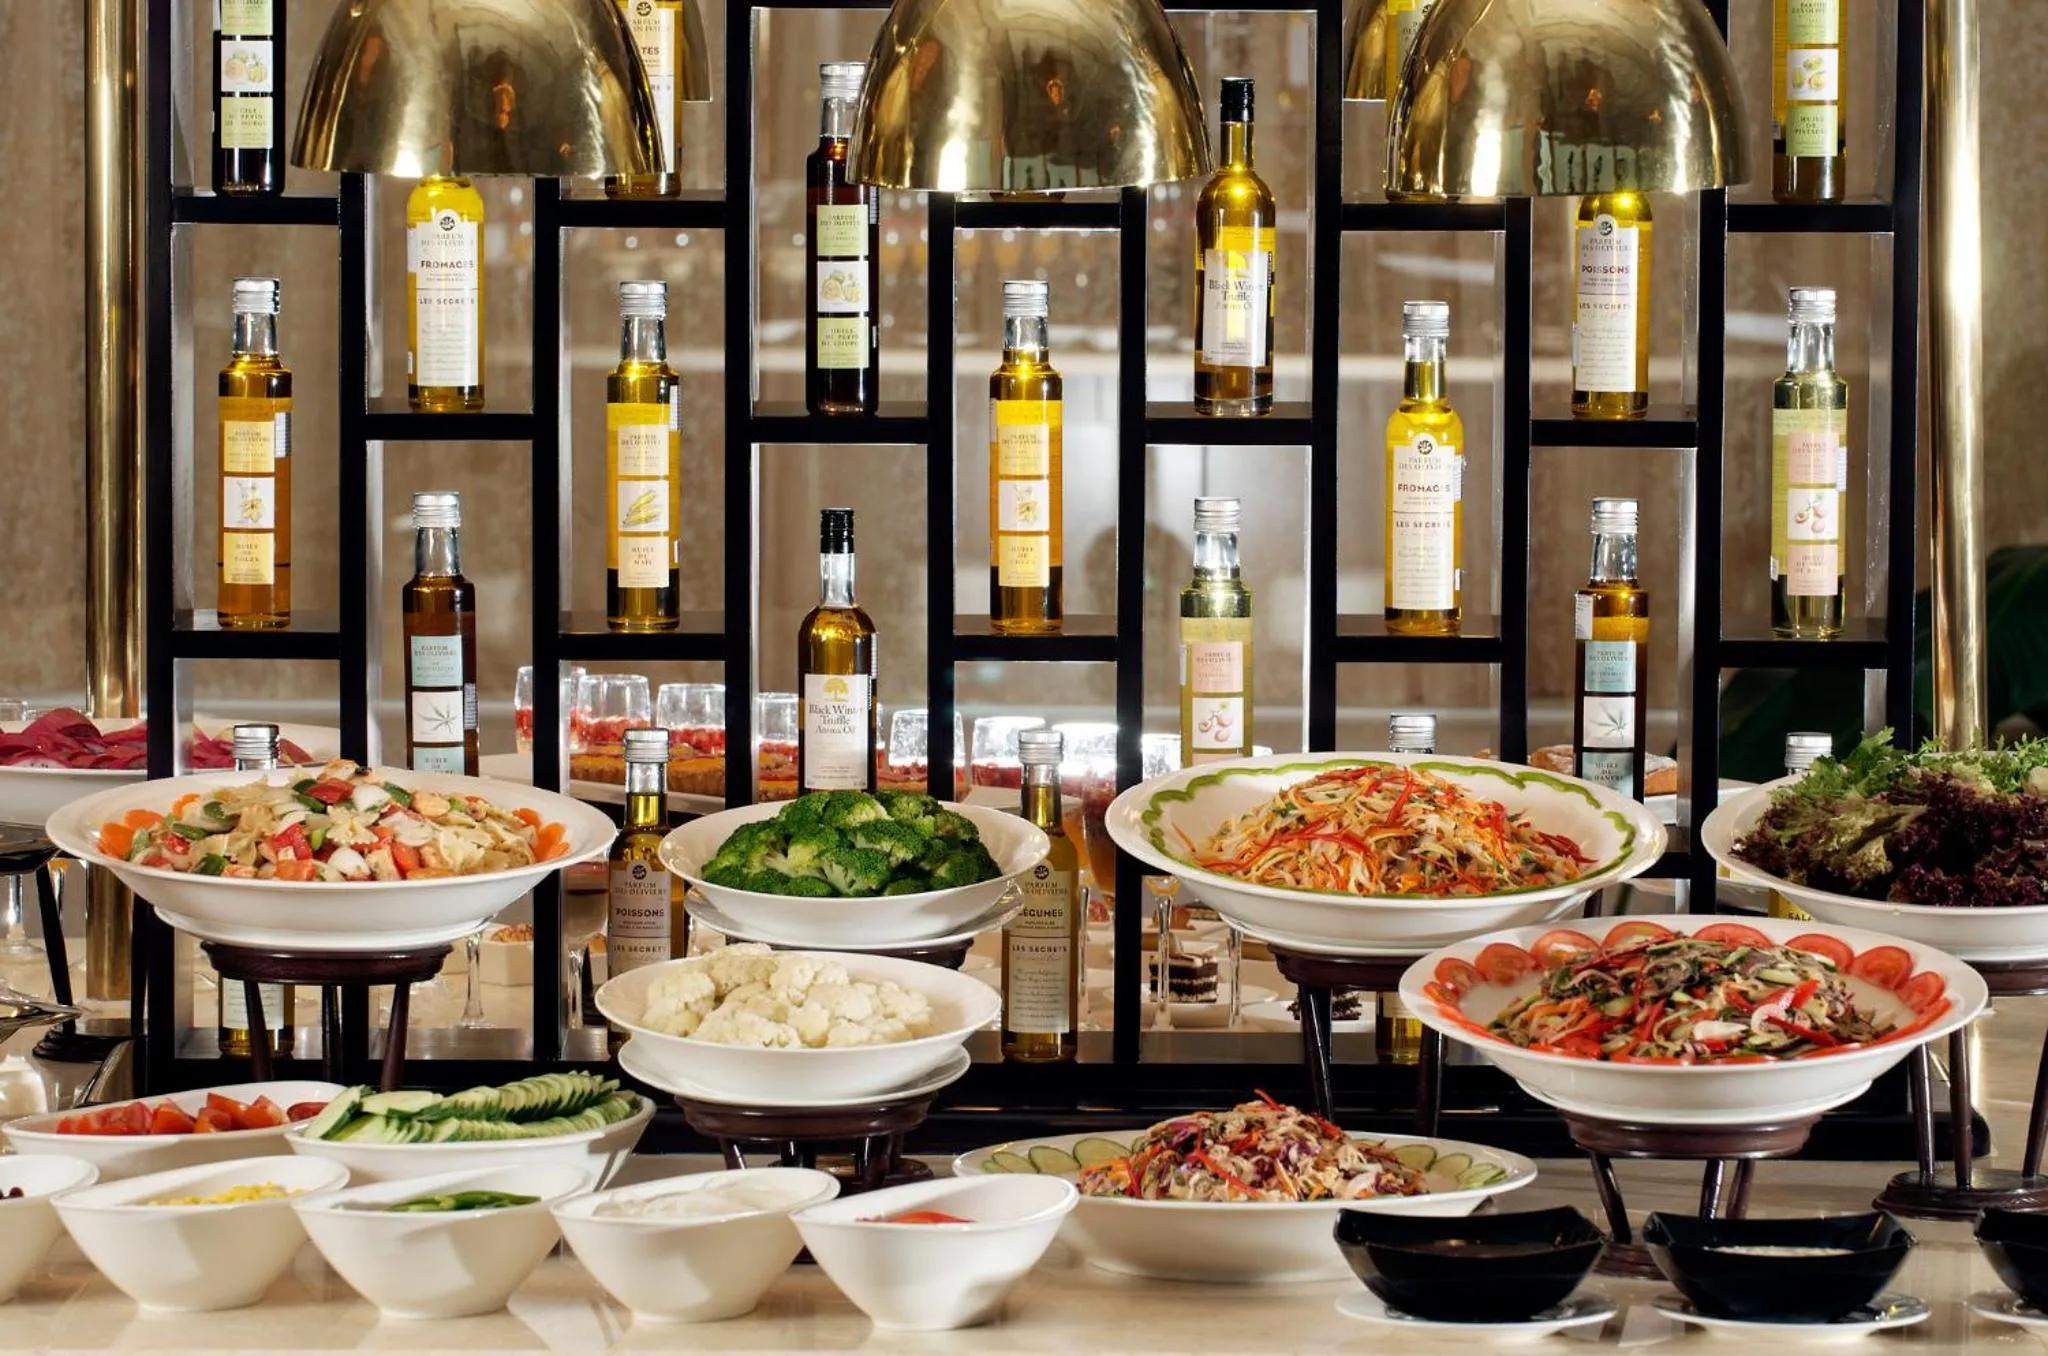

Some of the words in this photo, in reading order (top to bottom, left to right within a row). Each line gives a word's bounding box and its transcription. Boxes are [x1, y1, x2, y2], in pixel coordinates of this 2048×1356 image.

[641, 47, 660, 55] TES
[1581, 265, 1630, 274] POISSONS
[1209, 280, 1230, 290] Black
[808, 704, 831, 714] Black
[820, 715, 851, 725] Truffle
[615, 908, 665, 917] POISSONS
[1011, 944, 1026, 952] LES
[1028, 945, 1068, 953] SECRETS
